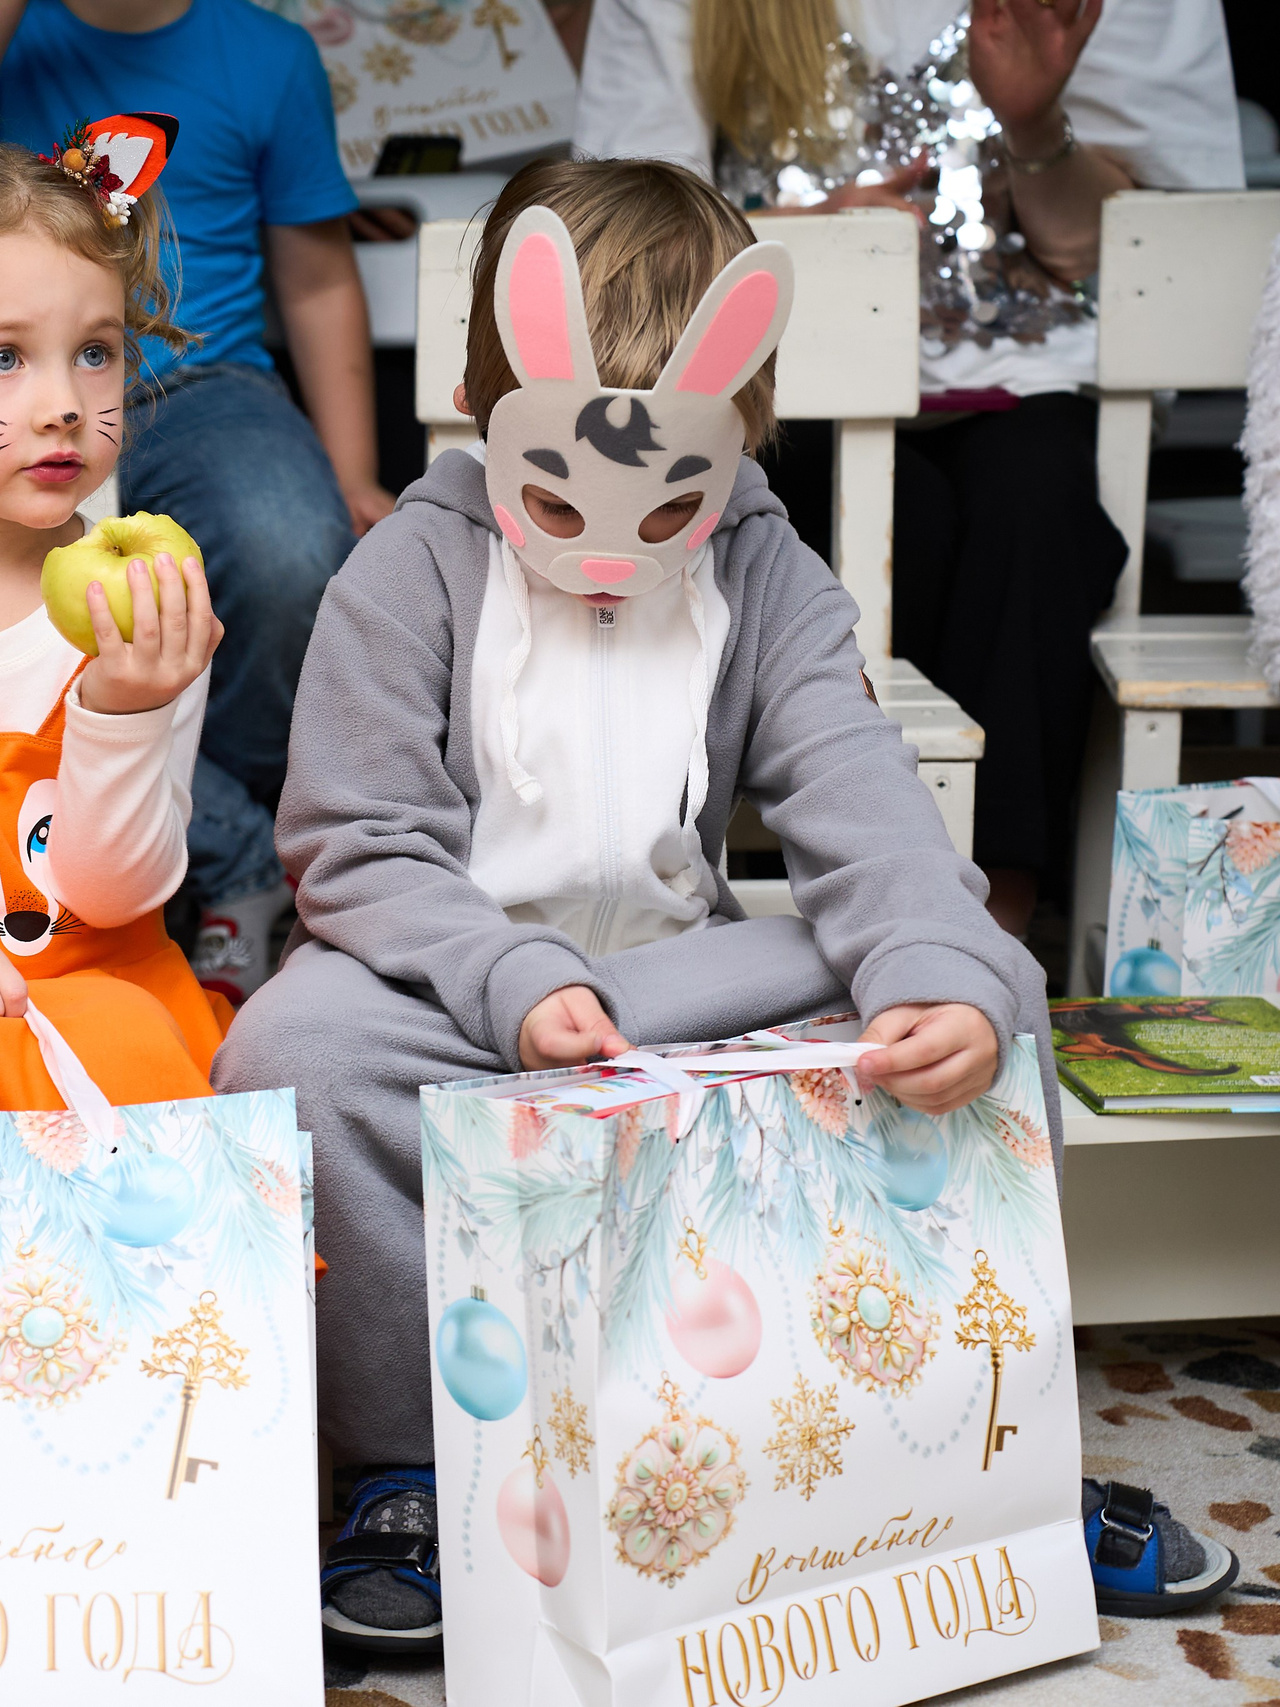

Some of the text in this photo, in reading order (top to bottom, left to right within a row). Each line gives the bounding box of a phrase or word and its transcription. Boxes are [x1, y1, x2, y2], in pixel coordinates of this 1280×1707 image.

[736, 1507, 954, 1604] Волшебного
[44, 1591, 235, 1685] ГОДА
[676, 1546, 1036, 1707] НОВОГО ГОДА
